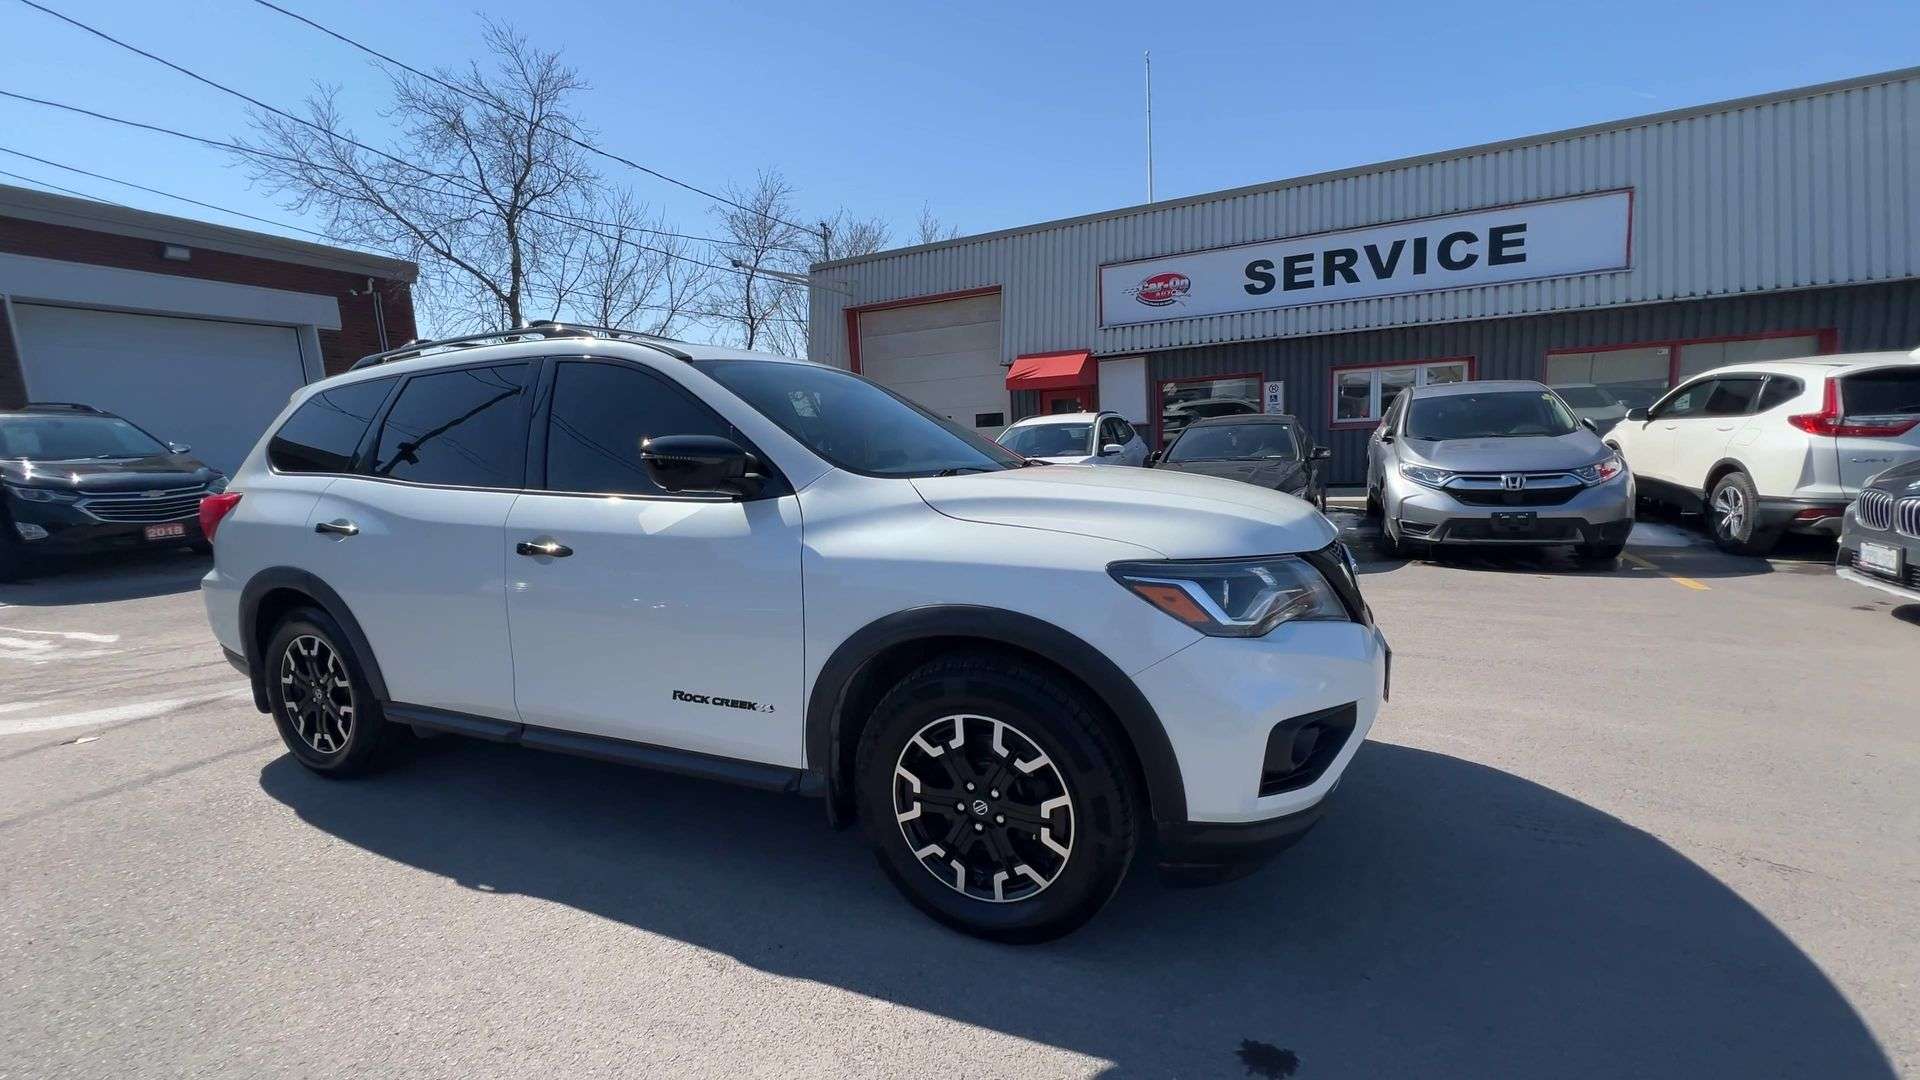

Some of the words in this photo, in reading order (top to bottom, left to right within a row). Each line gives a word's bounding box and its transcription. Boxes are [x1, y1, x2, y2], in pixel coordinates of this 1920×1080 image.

[1244, 223, 1528, 296] SERVICE
[146, 526, 183, 537] 2018
[672, 690, 710, 704] ROCK
[711, 697, 758, 711] CREEK
